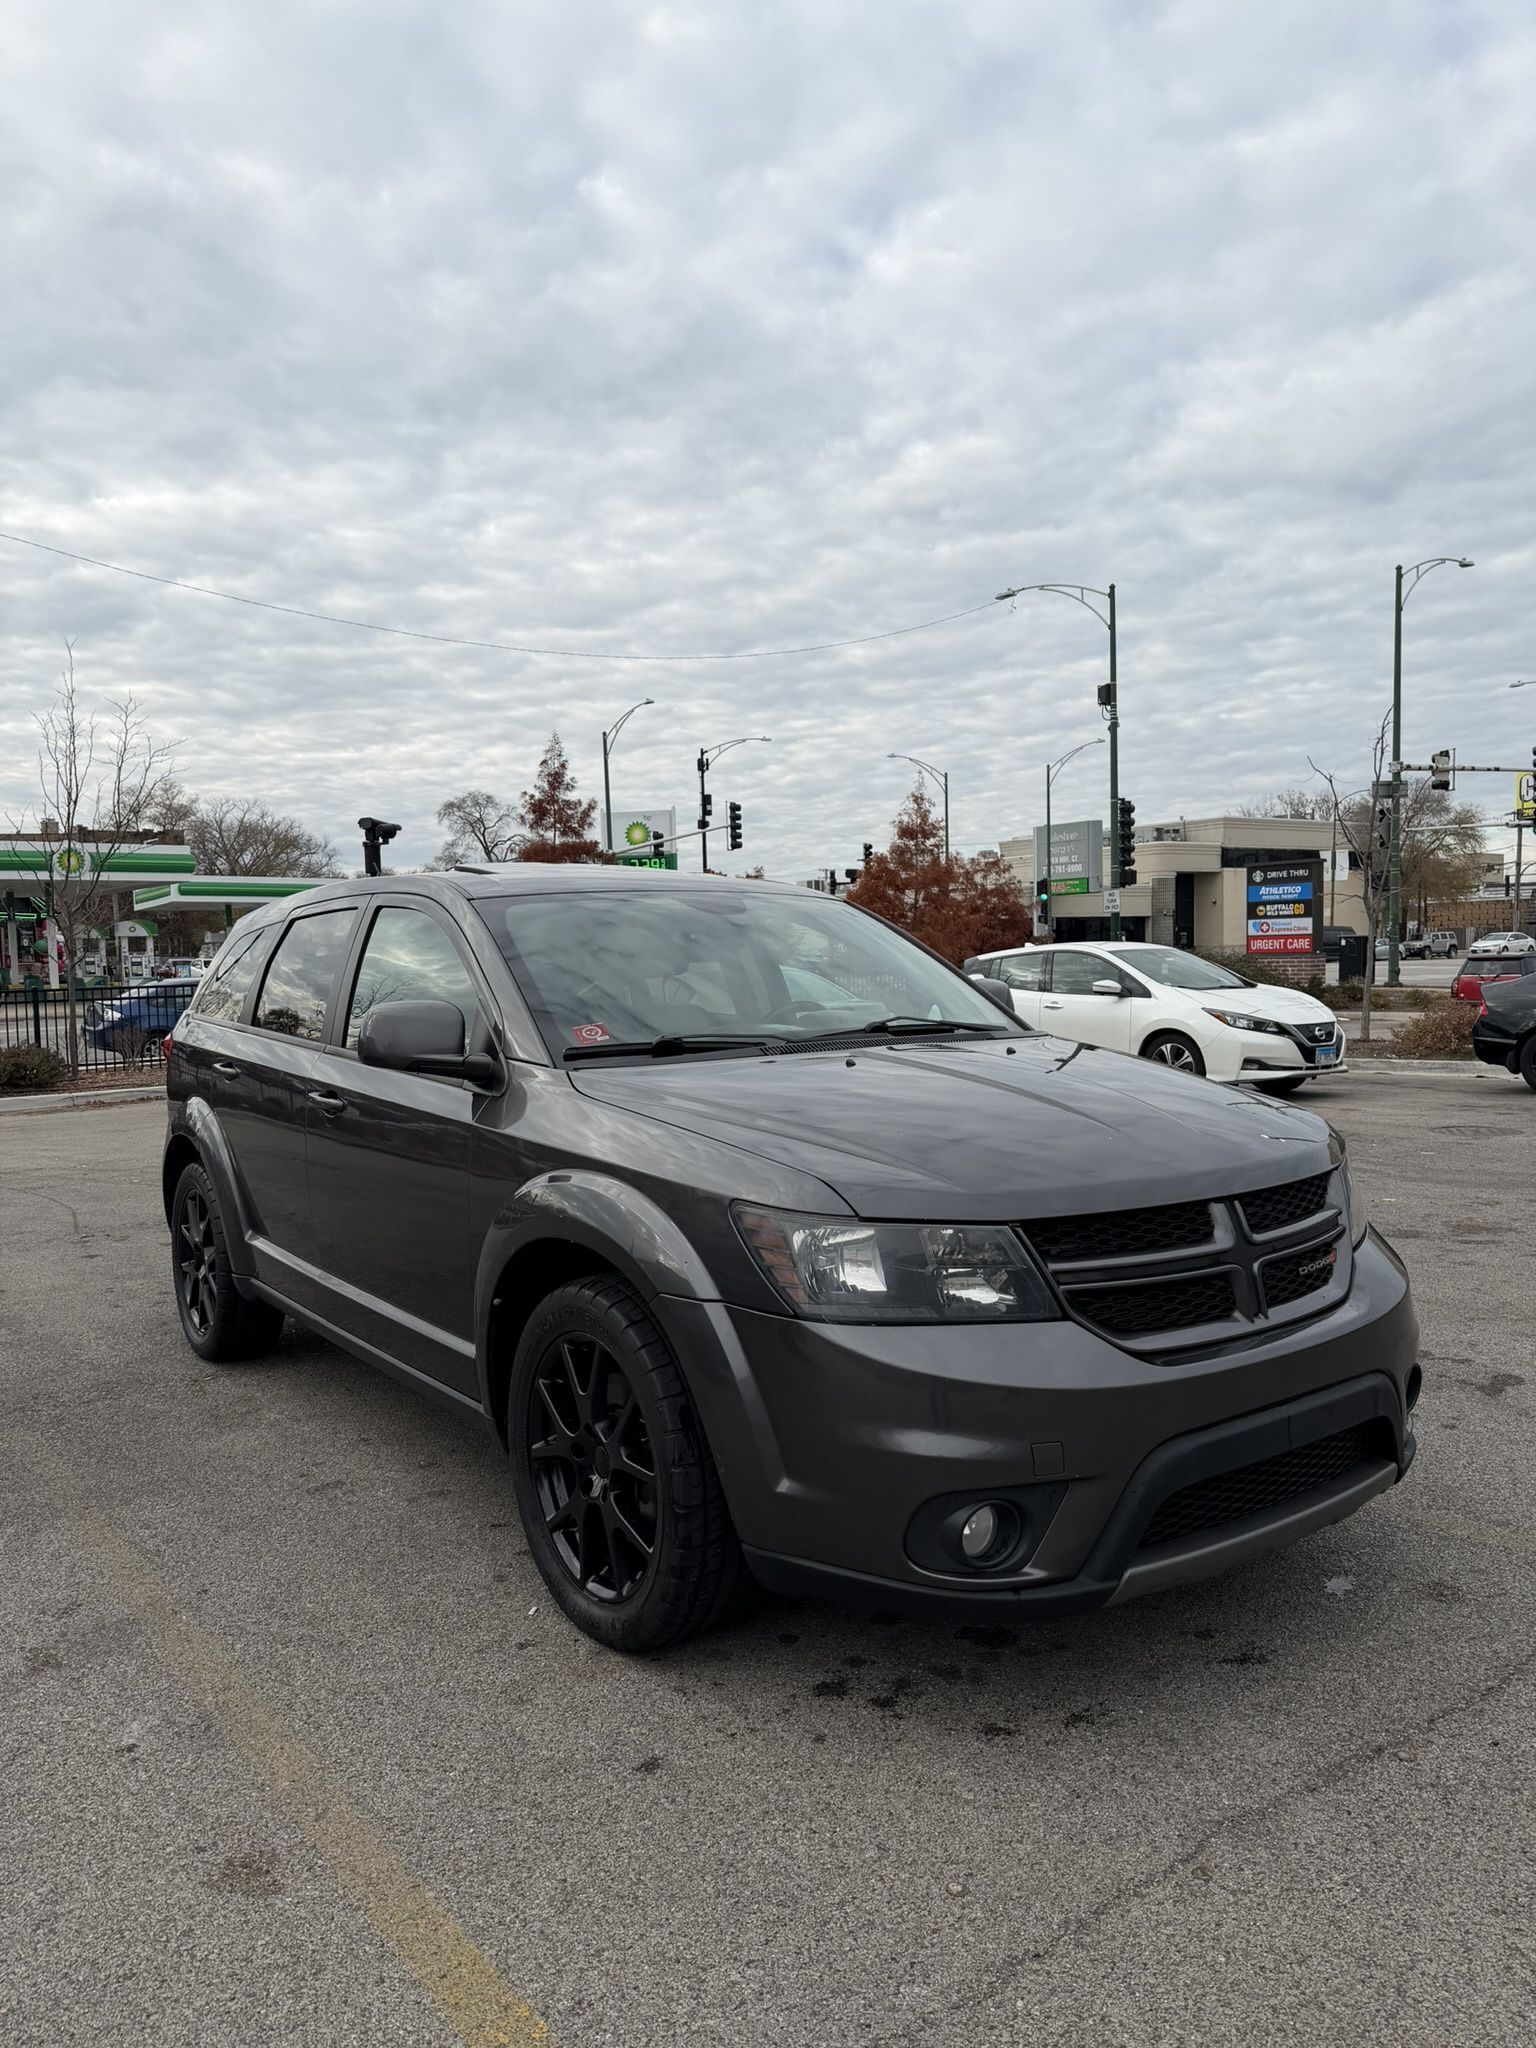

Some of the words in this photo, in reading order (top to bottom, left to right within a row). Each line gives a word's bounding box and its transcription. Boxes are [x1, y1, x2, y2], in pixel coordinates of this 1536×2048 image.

[1267, 871, 1288, 879] DRIVE
[1290, 869, 1309, 877] THRU
[1259, 886, 1302, 895] ATHLETICO
[1294, 903, 1305, 915] GO
[1250, 940, 1286, 950] URGENT
[1287, 939, 1310, 949] CARE
